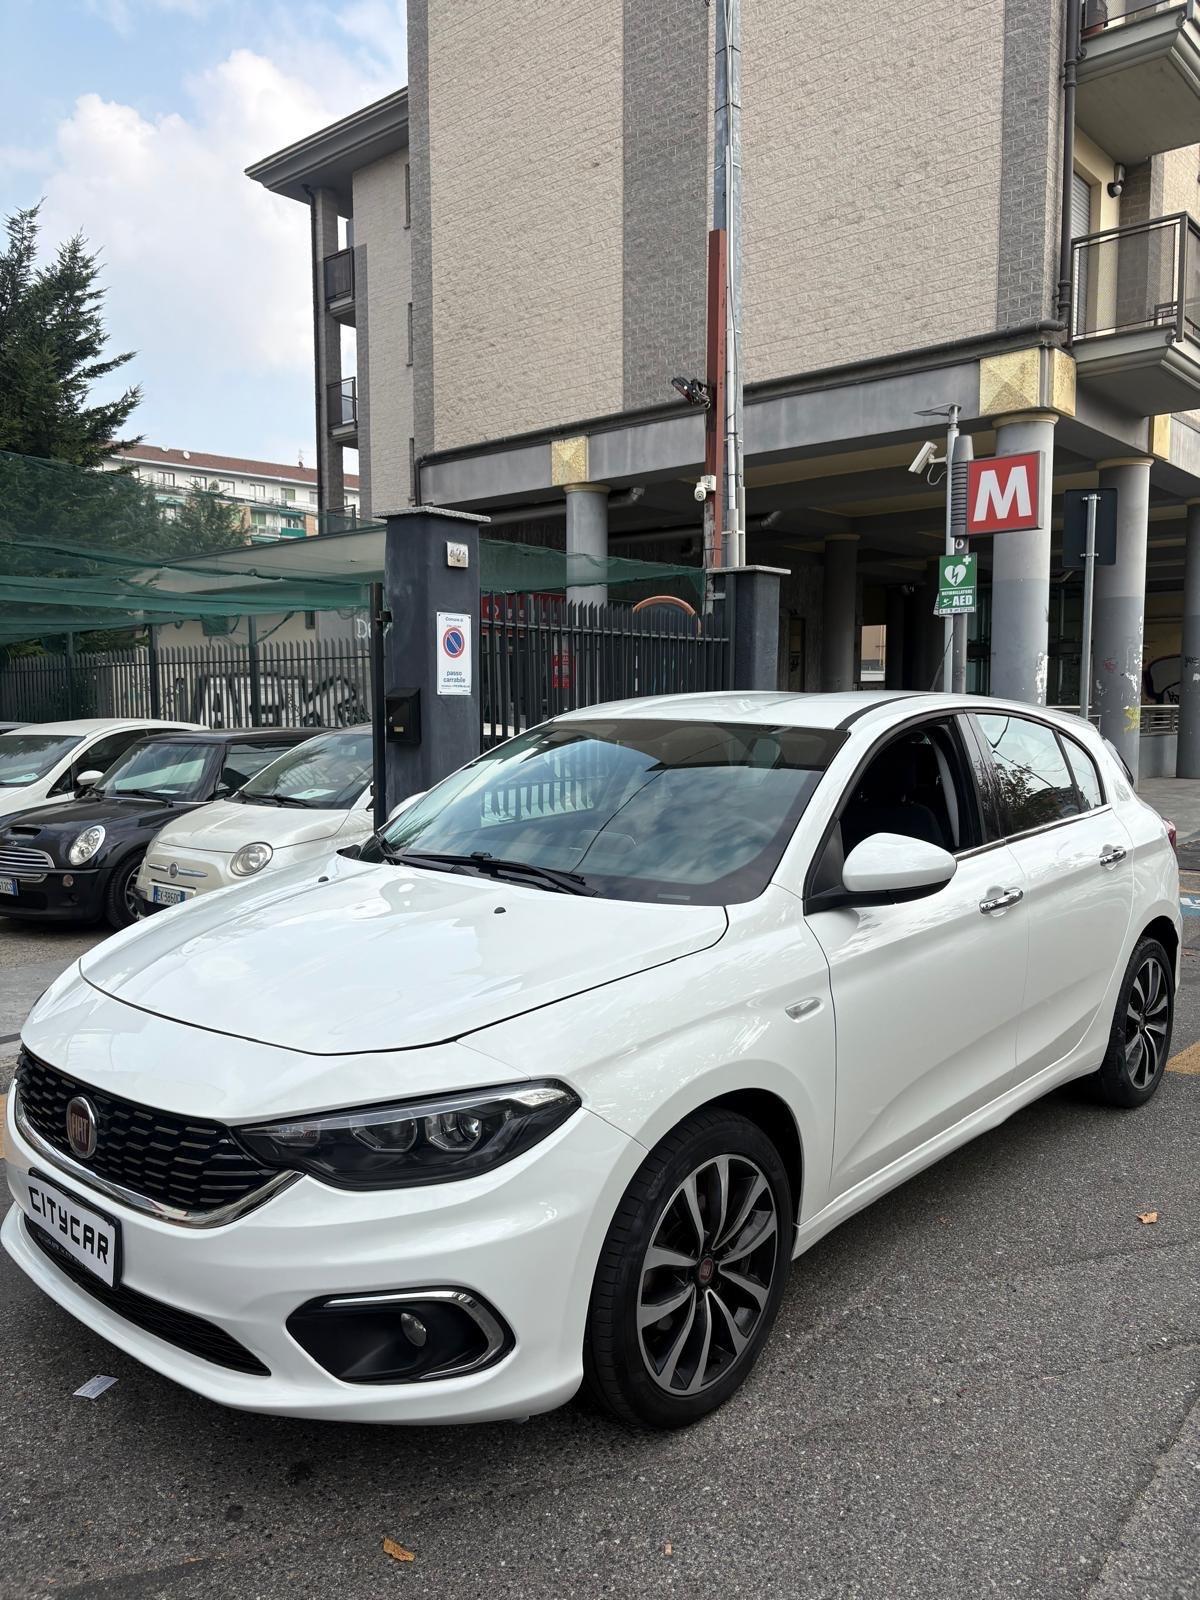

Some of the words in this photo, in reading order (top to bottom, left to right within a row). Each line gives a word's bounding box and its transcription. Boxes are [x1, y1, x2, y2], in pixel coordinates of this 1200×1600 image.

[973, 465, 1032, 522] M
[952, 594, 973, 606] AED
[71, 1112, 89, 1145] FIAT
[28, 1185, 109, 1265] CITYCAR
